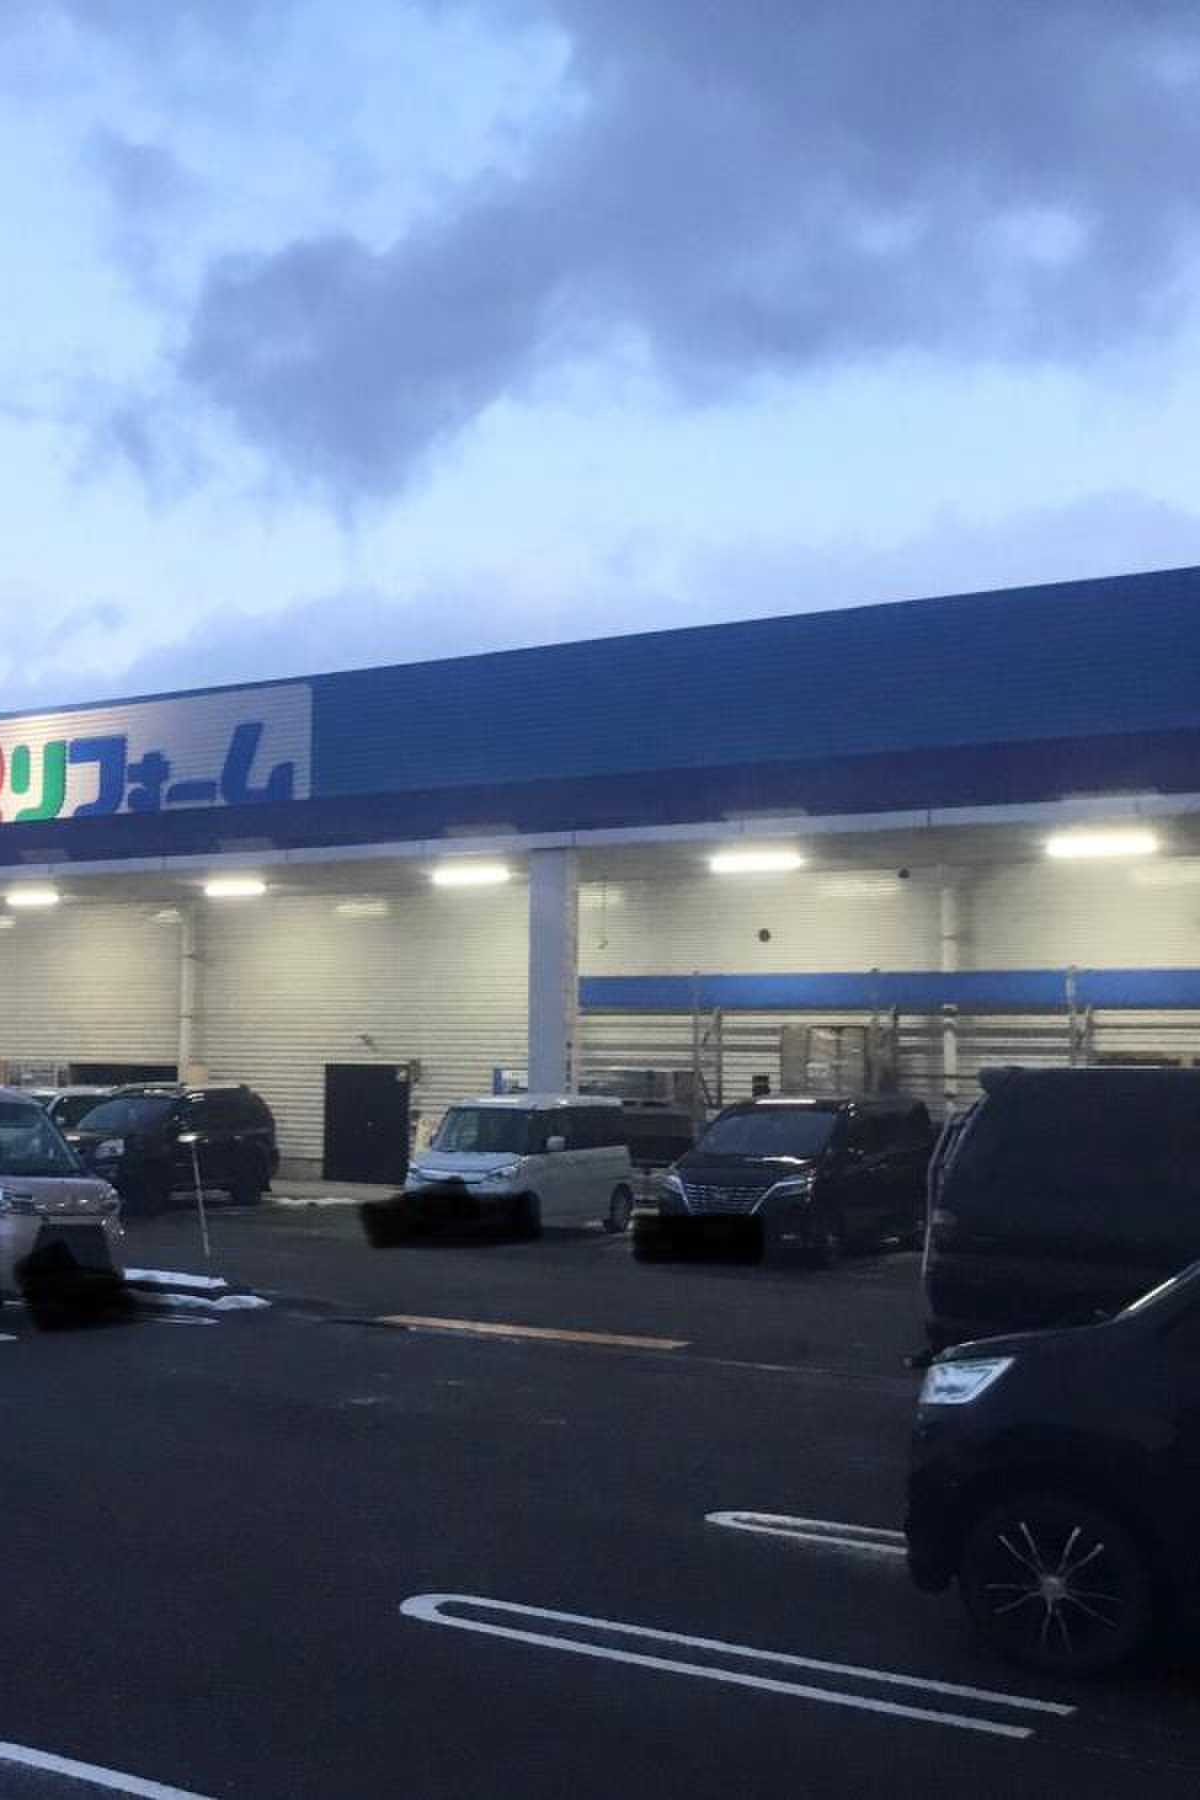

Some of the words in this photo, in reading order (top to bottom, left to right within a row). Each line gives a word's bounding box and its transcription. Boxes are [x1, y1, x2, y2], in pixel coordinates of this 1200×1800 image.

[10, 722, 294, 822] リフォーム
